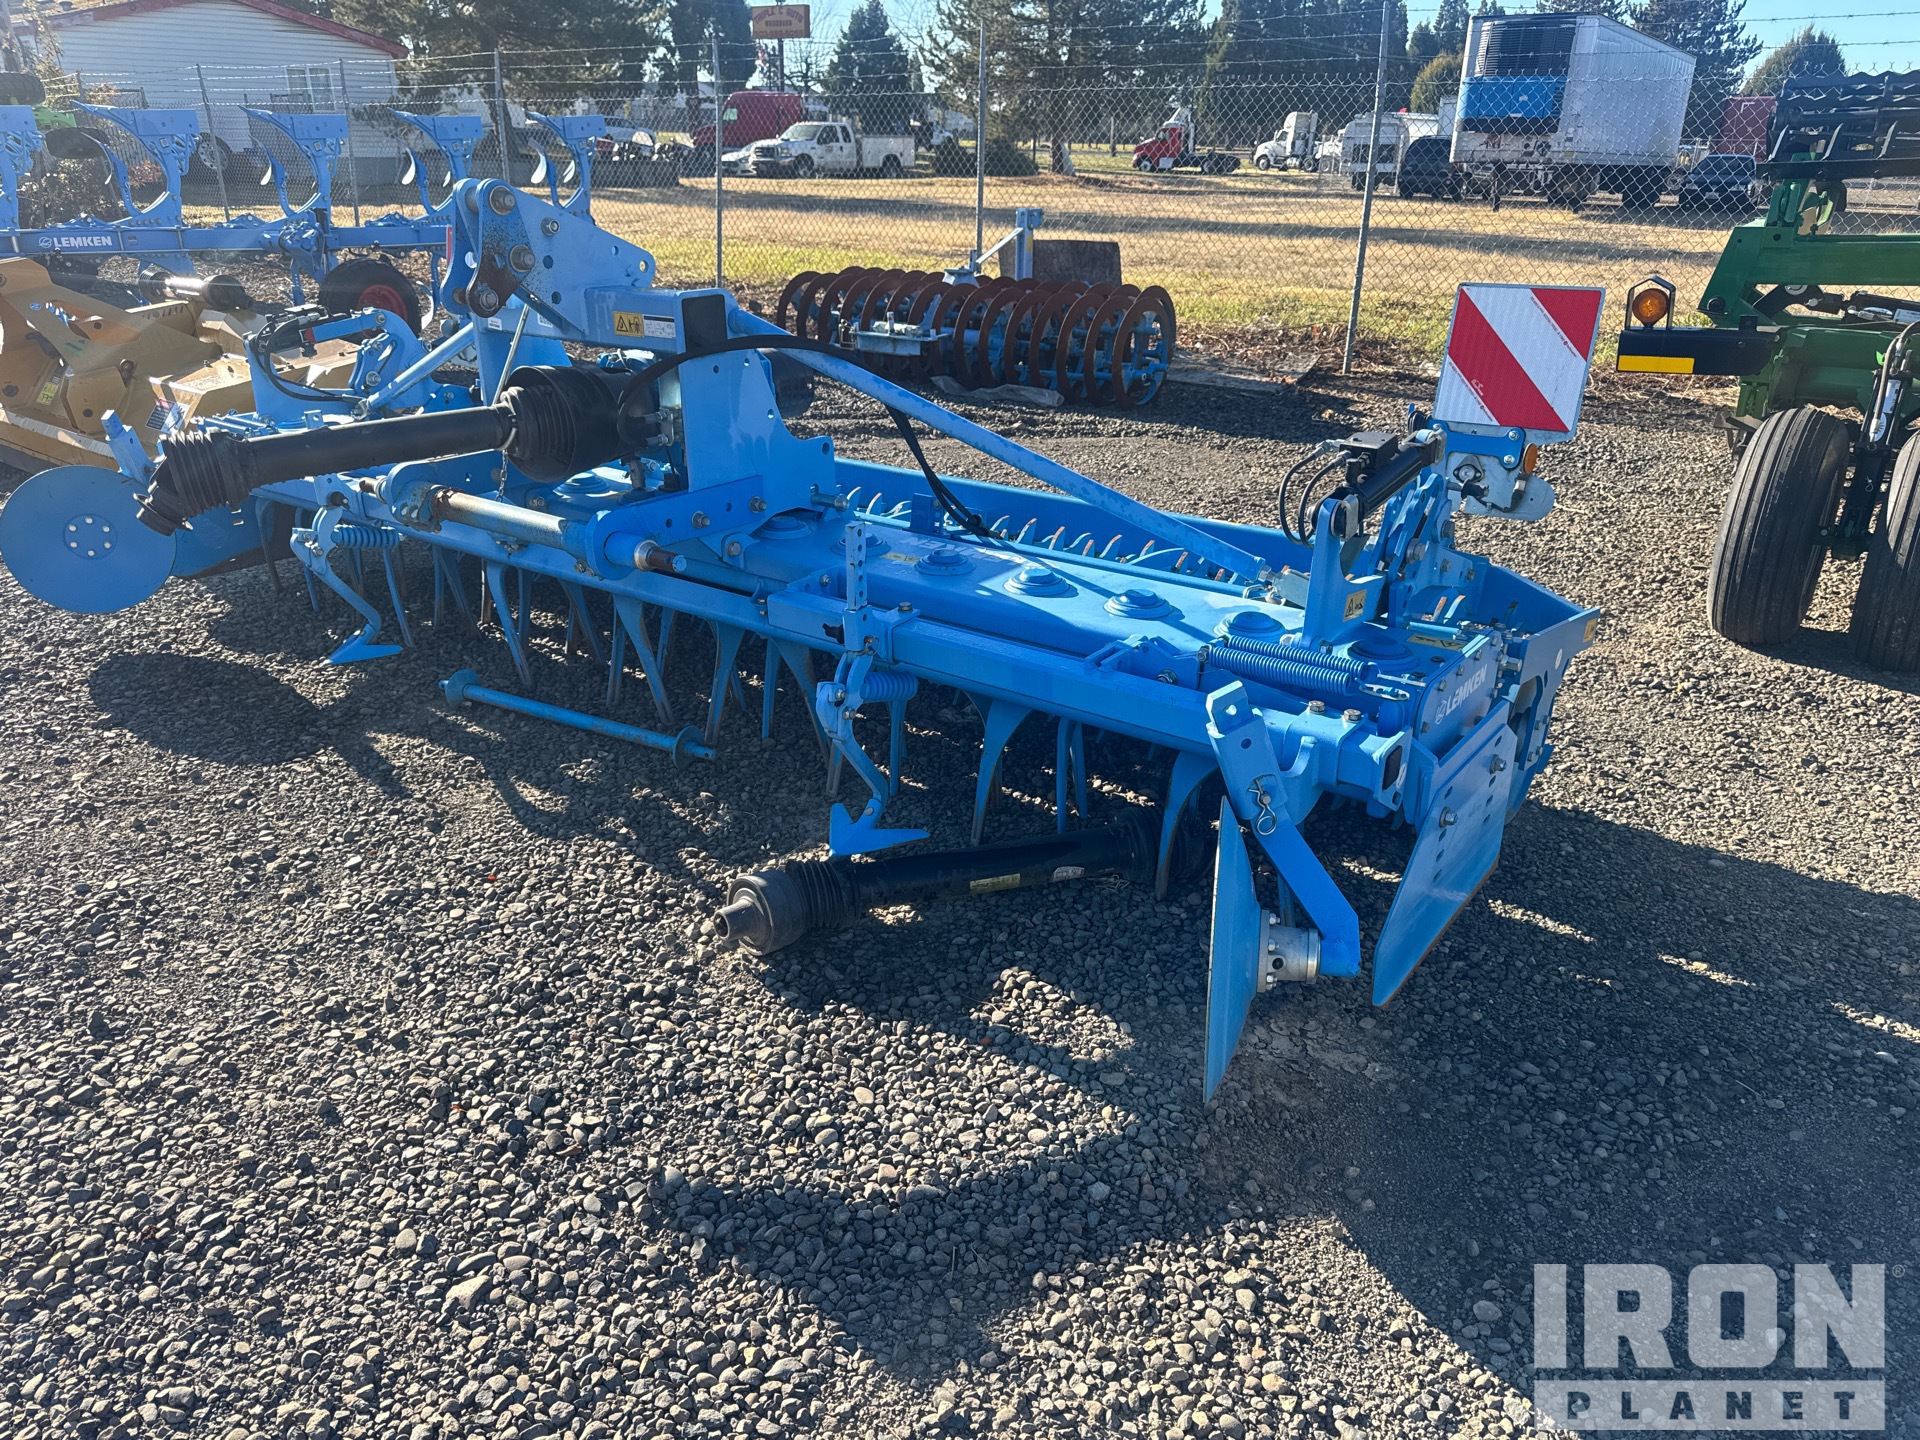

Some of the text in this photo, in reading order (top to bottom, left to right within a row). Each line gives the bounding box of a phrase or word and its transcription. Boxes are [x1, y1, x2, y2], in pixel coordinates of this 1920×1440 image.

[786, 8, 804, 23] AUTO
[53, 236, 112, 248] LEMKEN
[1445, 663, 1487, 716] LEMKEN
